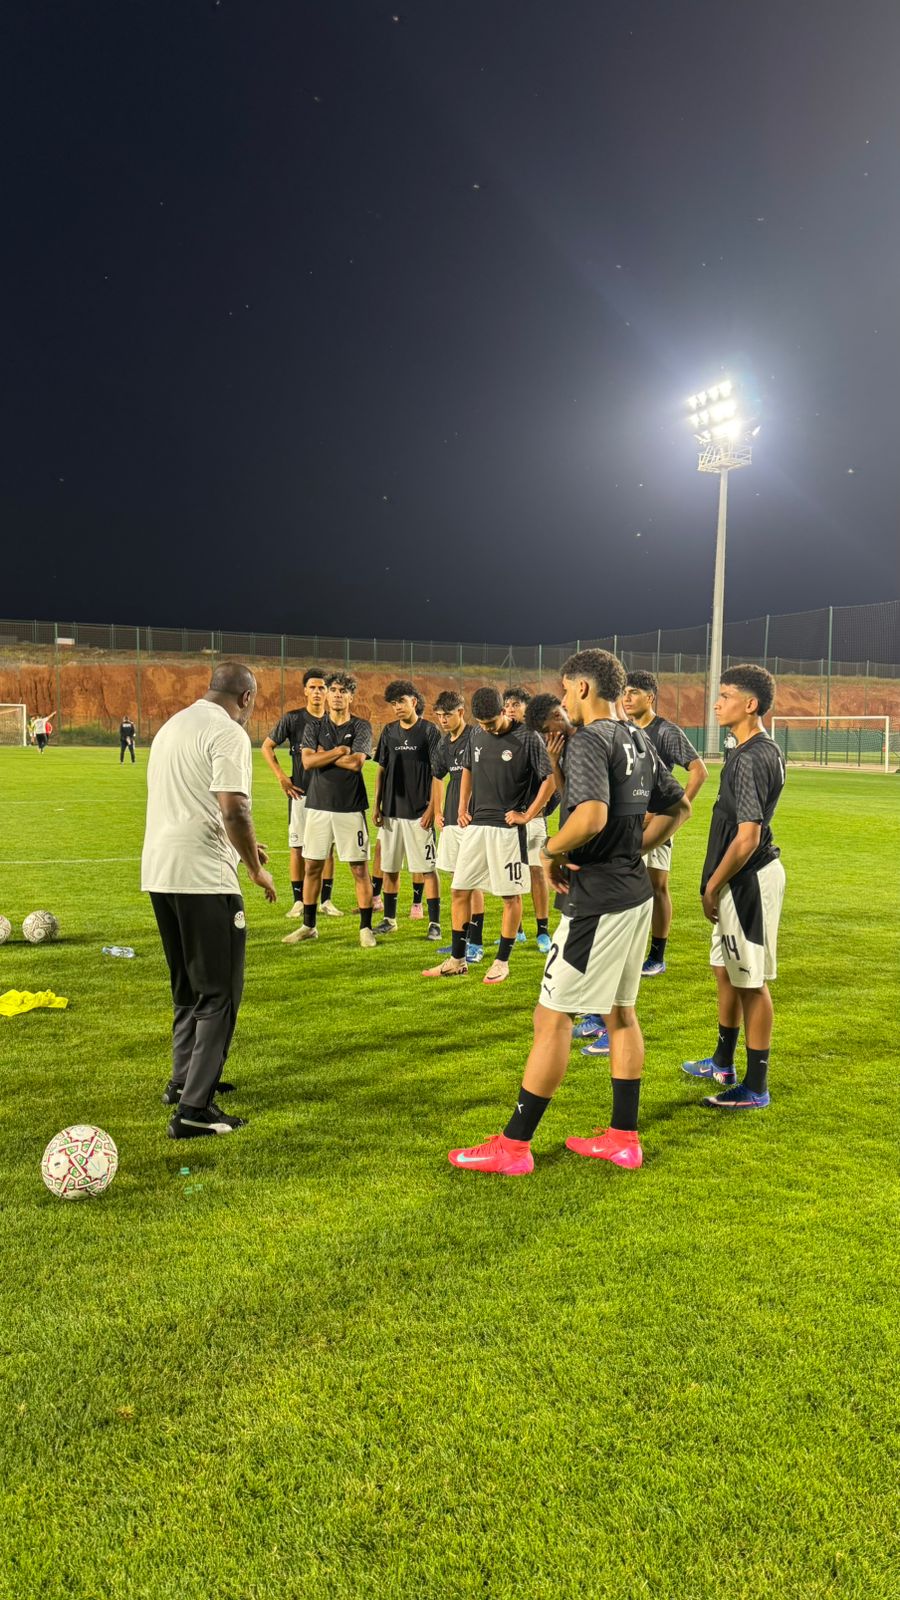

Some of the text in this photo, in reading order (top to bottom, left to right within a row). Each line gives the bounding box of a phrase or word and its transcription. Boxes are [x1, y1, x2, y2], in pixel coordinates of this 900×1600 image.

[357, 830, 364, 847] 8
[504, 861, 522, 881] 10
[721, 934, 741, 961] 14
[544, 942, 559, 980] 2
